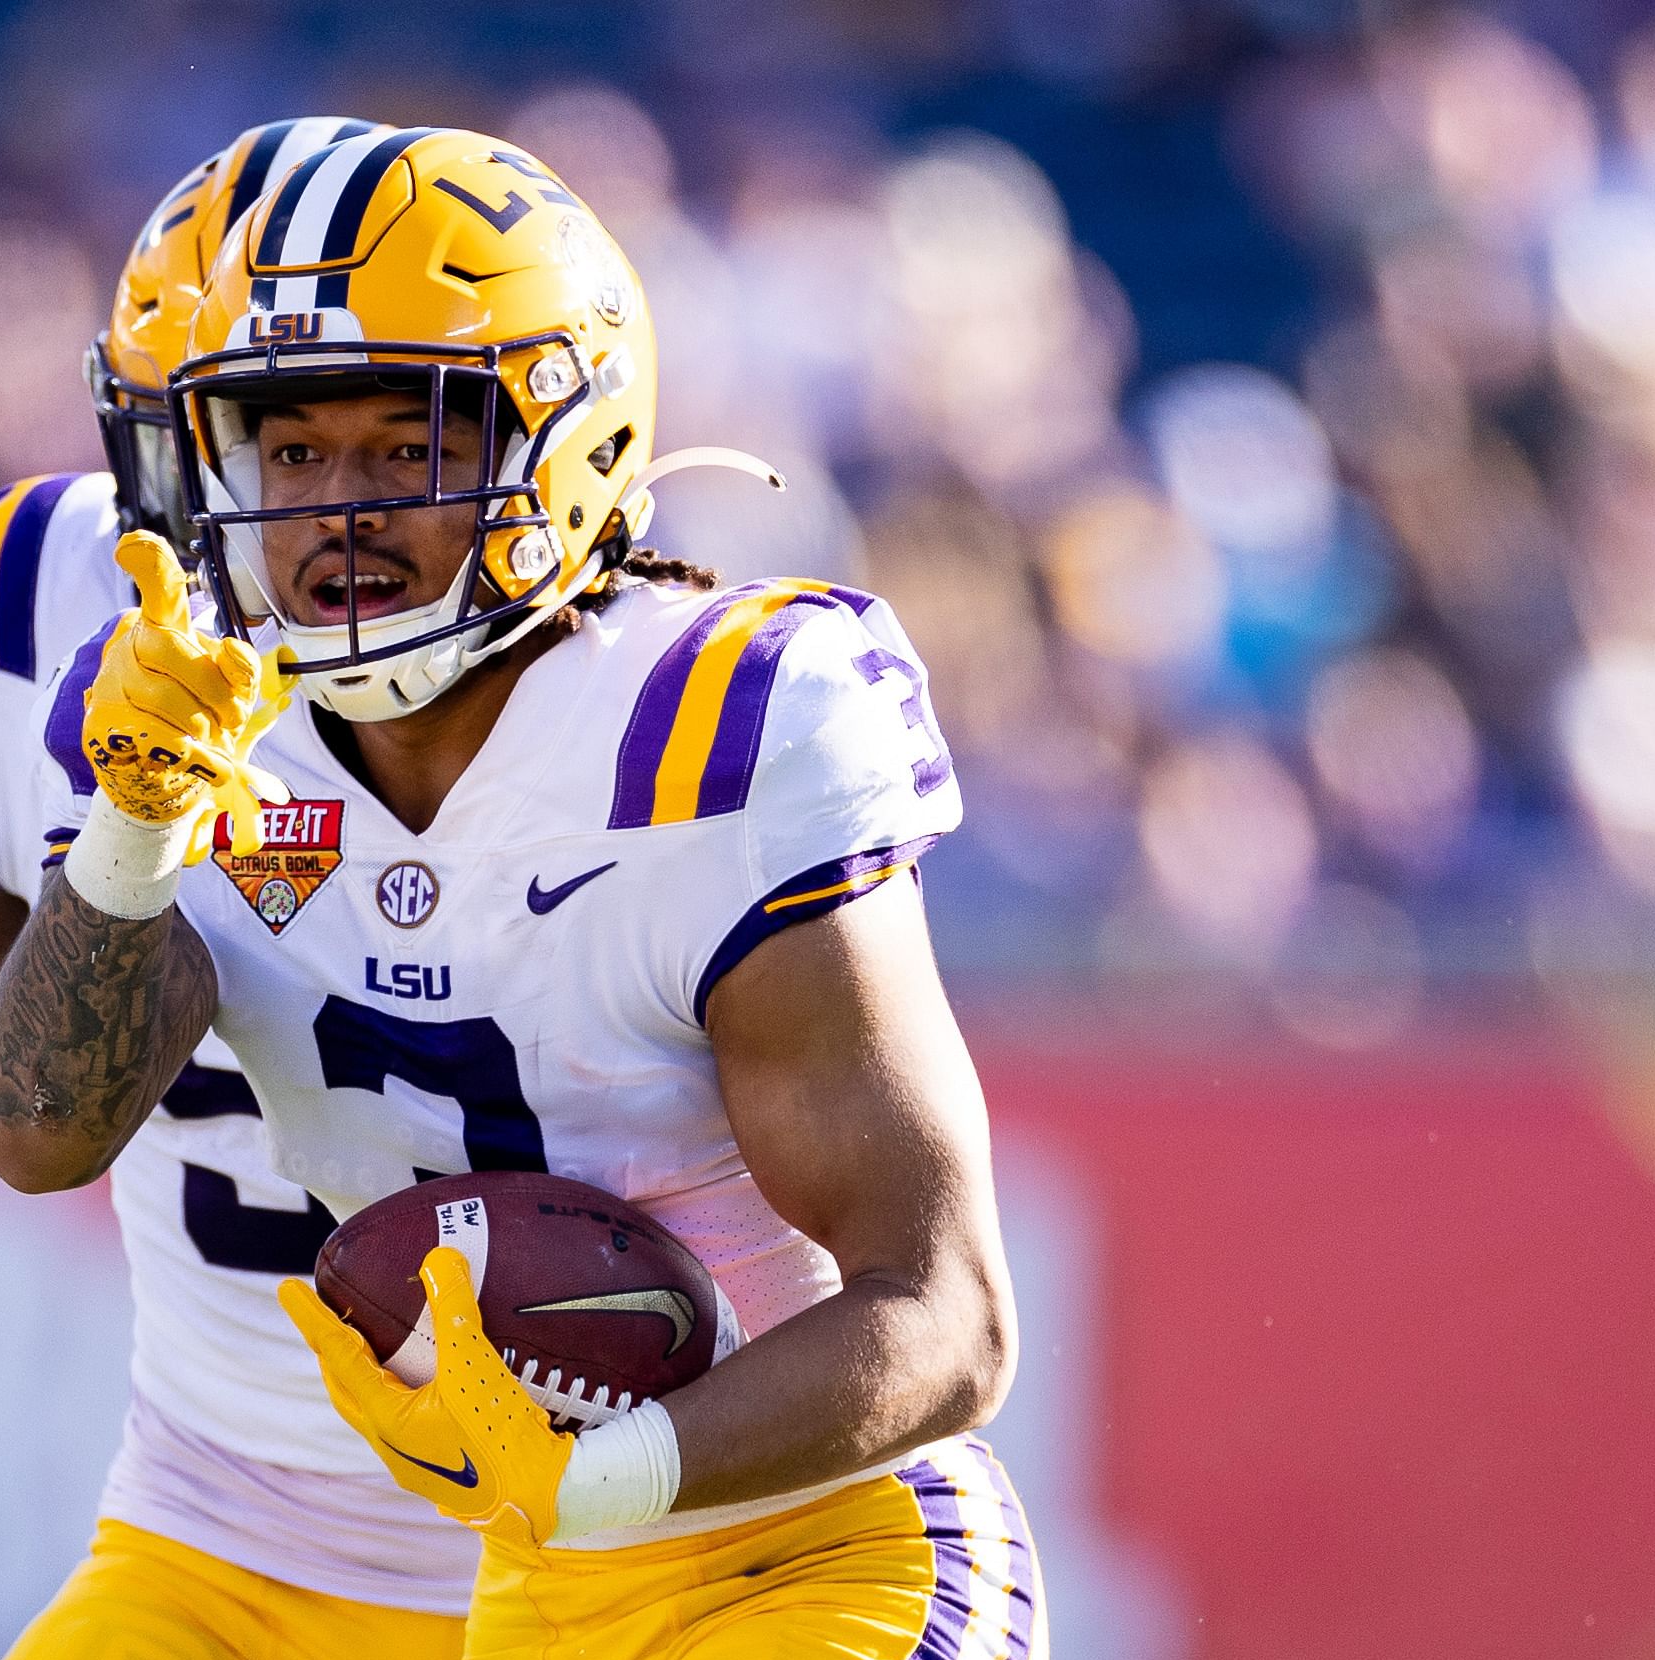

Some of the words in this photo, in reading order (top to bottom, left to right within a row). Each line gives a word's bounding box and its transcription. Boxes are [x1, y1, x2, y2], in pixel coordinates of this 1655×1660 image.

[249, 313, 323, 346] LSU
[232, 856, 280, 872] CITRUS
[286, 856, 325, 872] BOWL
[380, 864, 437, 925] SEC
[365, 957, 452, 1001] LSU
